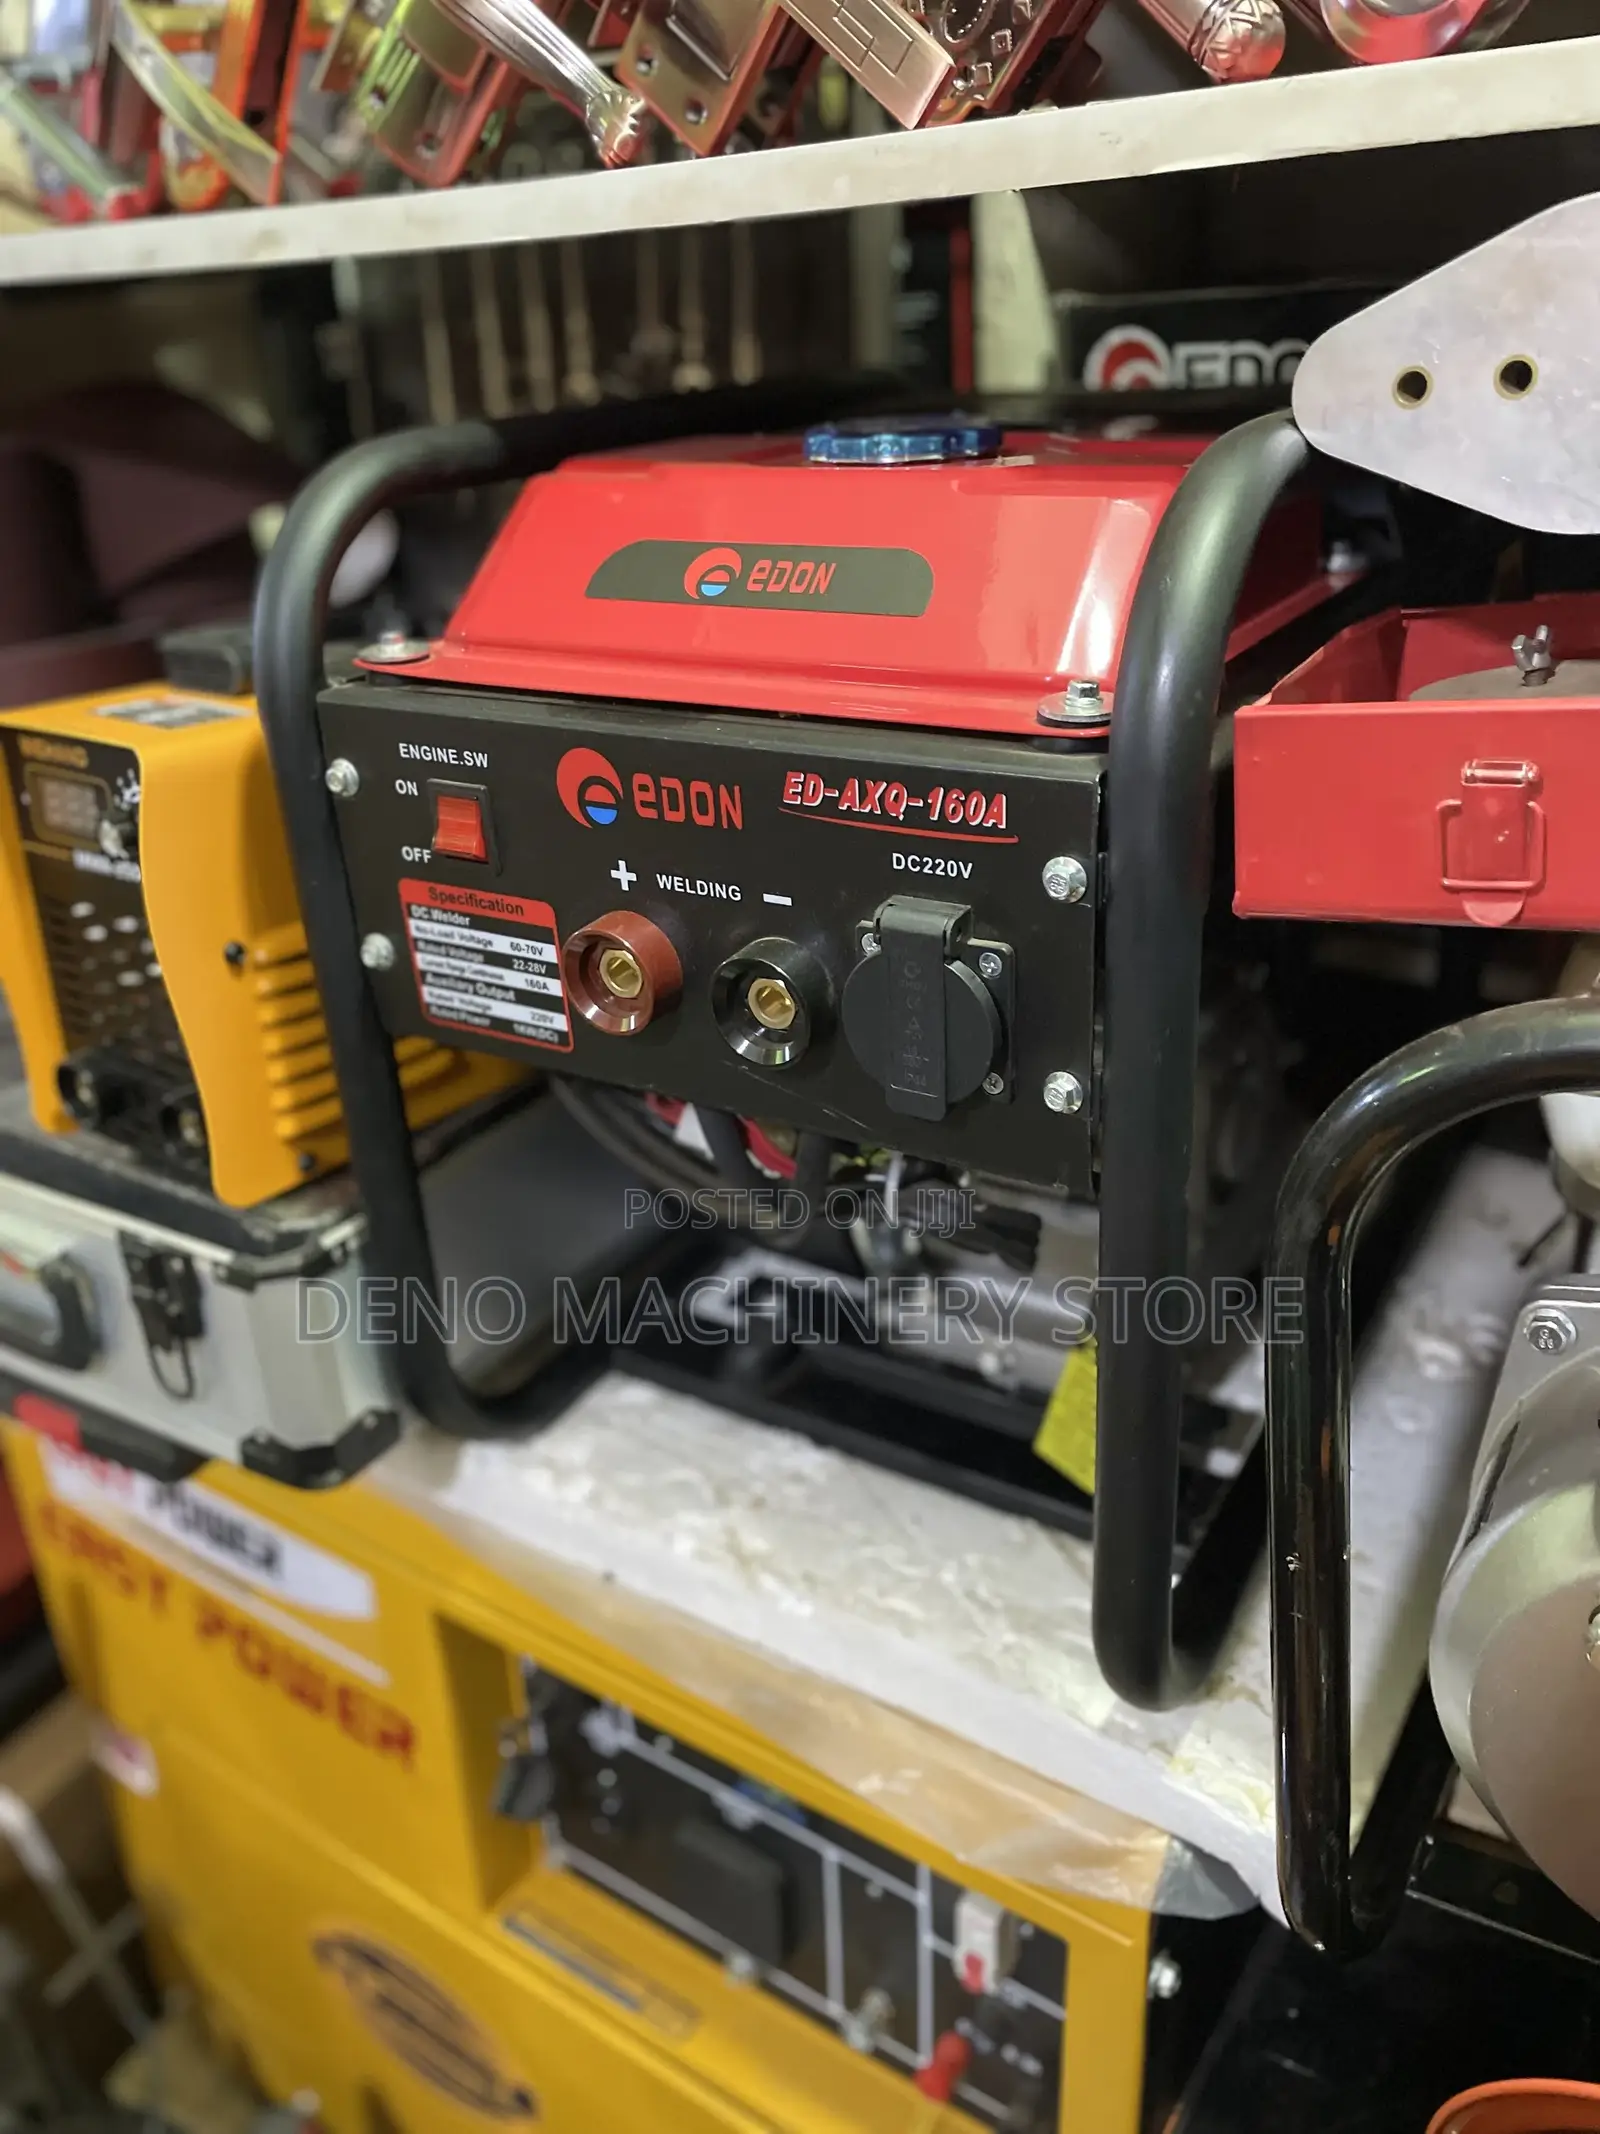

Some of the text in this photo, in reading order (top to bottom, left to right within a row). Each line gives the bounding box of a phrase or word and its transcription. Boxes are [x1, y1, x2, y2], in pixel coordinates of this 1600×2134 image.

[399, 743, 488, 768] ENGINE.SW
[395, 779, 419, 797] ON
[782, 770, 1009, 830] ED-AXQ-160A
[402, 846, 432, 864] OFF
[892, 852, 974, 881] DC220V
[656, 873, 742, 902] WELDING
[428, 886, 525, 917] Specification
[457, 931, 493, 949] Voltage
[510, 941, 544, 957] 60-70V
[512, 958, 547, 974] 22-28V
[524, 978, 549, 992] 160A
